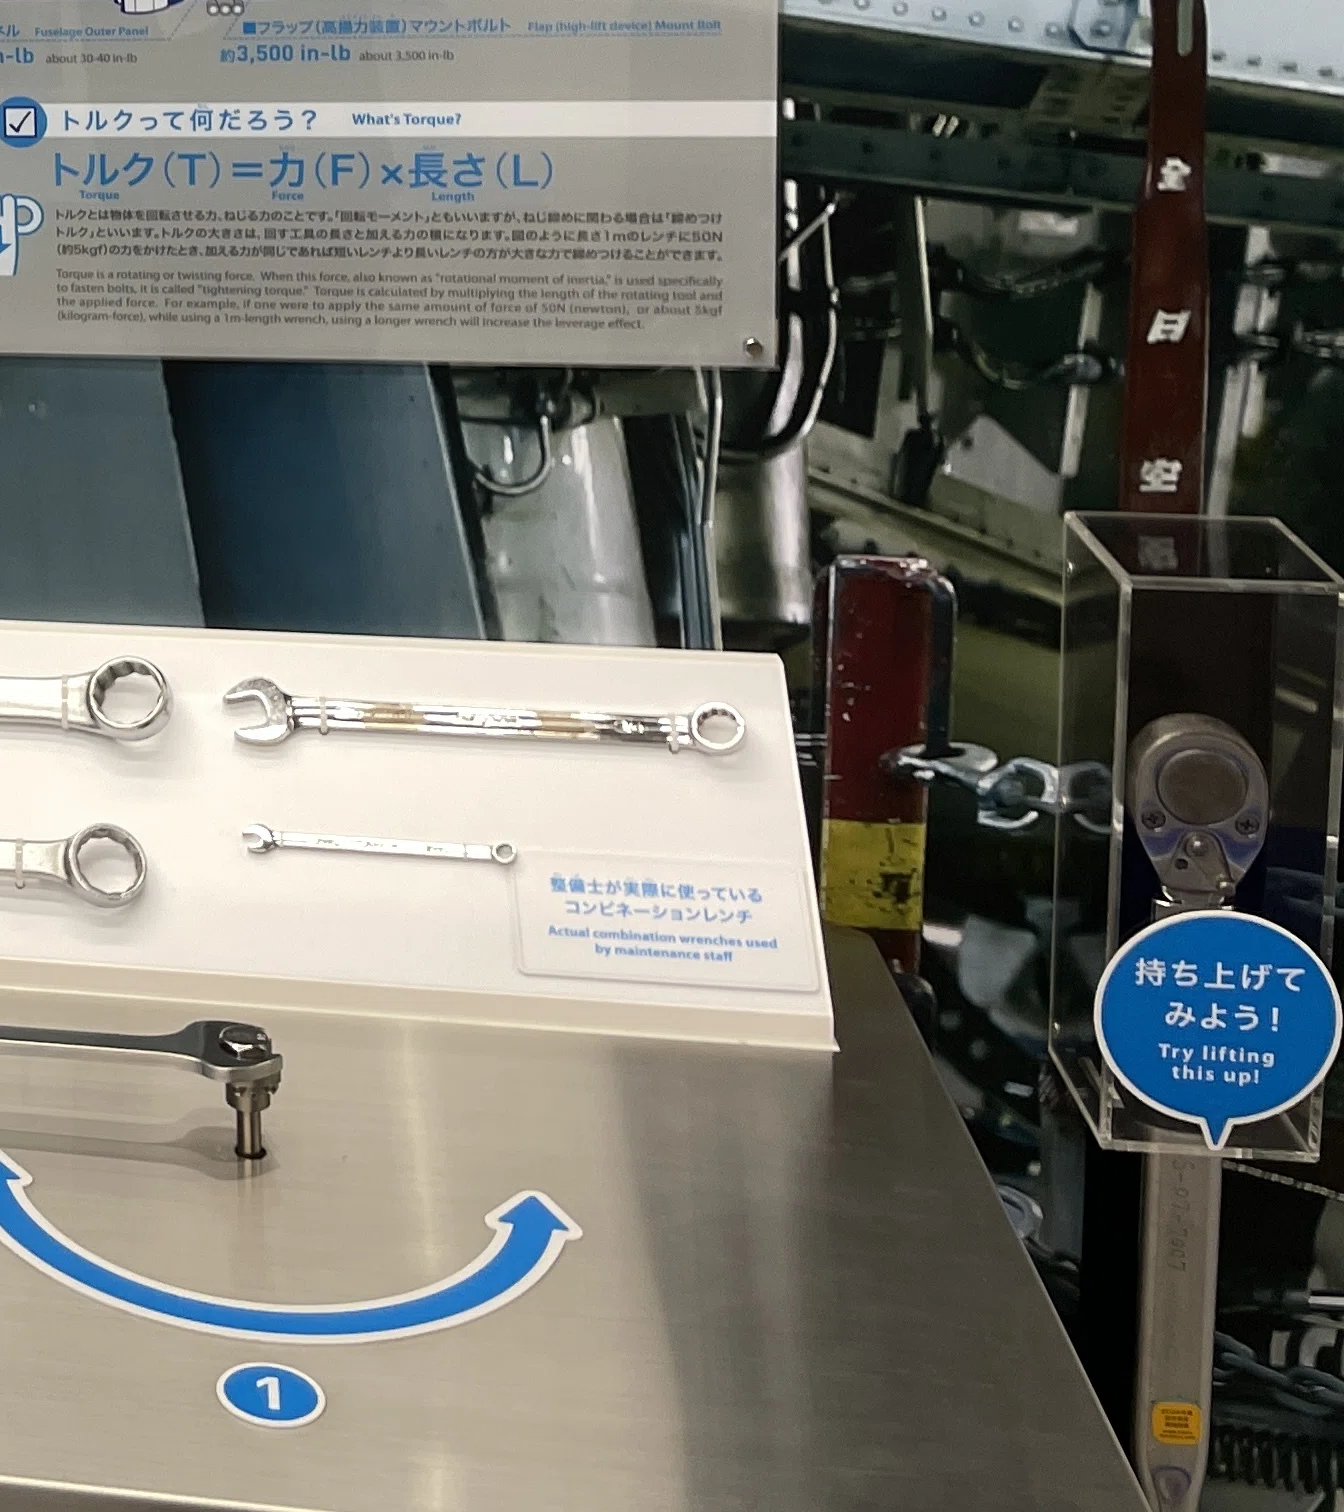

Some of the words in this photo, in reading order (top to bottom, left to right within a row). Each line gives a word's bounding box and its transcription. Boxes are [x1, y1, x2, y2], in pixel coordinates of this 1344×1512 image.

[34, 26, 83, 39] Fuselage
[85, 26, 116, 37] Outer
[118, 26, 149, 36] Panel
[527, 21, 553, 34] Flap
[654, 20, 693, 31] Mount
[697, 20, 721, 30] Bolt
[45, 53, 77, 64] about
[113, 53, 137, 64] in-lb
[220, 44, 293, 64] 約3,500
[300, 43, 351, 62] in-lb
[359, 51, 393, 62] about
[395, 51, 426, 63] 3,500
[428, 50, 454, 62] in-lb
[352, 113, 401, 126] What's
[402, 113, 461, 128] Torque?
[79, 189, 120, 202] Torque
[271, 190, 304, 201] Force
[431, 191, 475, 204] Length
[550, 876, 763, 903] 整備士が実際に使っている
[565, 899, 753, 924] コンビネーションレンチ
[548, 924, 590, 938] Actual
[593, 928, 676, 943] combination
[679, 934, 743, 948] wrenches
[746, 937, 778, 949] used
[595, 943, 611, 957] by
[615, 946, 701, 960] maintenance
[704, 950, 733, 962] staff
[1135, 957, 1306, 992] 持ち上げて
[1158, 1042, 1194, 1063] Try
[1202, 1045, 1276, 1068] lifting
[1171, 1065, 1215, 1081] this
[1223, 1070, 1260, 1087] up!
[256, 1377, 281, 1409] 1
